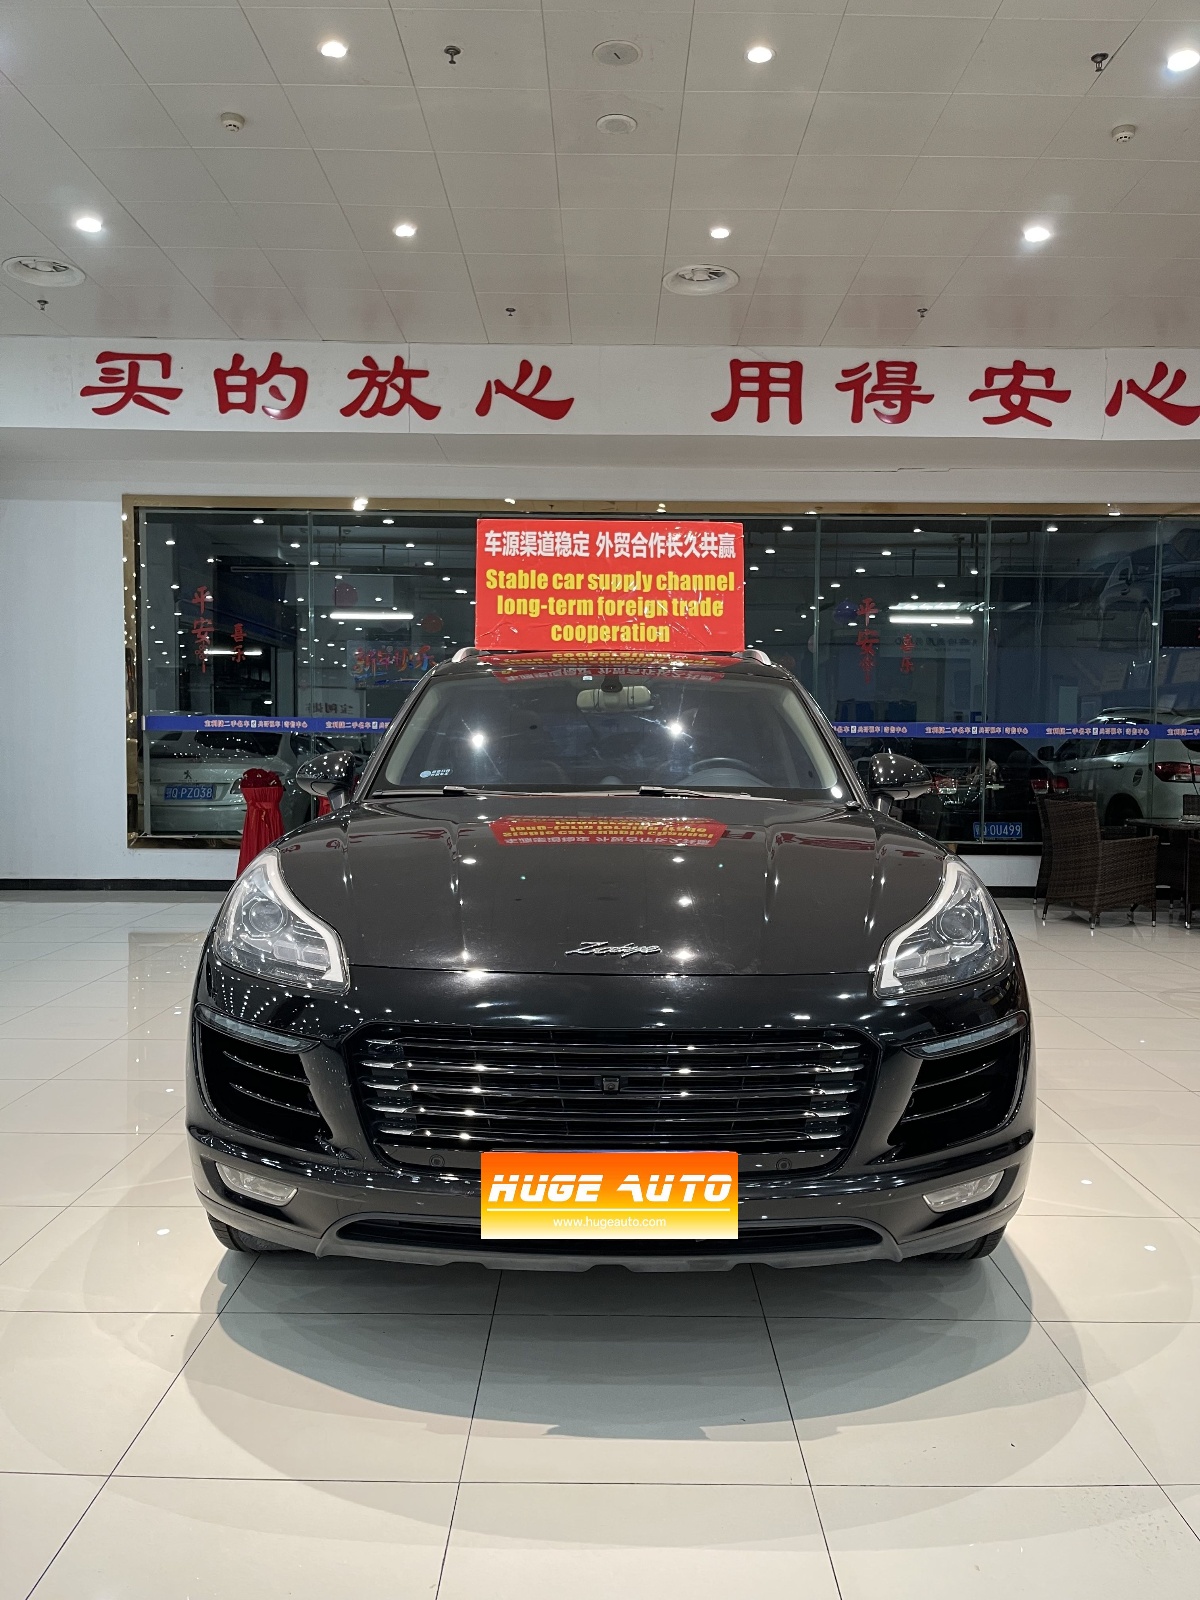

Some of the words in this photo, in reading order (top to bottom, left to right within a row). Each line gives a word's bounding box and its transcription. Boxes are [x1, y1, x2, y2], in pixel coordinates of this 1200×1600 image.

[79, 351, 576, 421] 买的放心
[710, 358, 1200, 428] 用得安心
[484, 530, 590, 558] 车源渠道稳定
[596, 531, 737, 559] 外贸合作长久共赢
[485, 568, 548, 590] Stable
[552, 572, 584, 591] car
[587, 570, 652, 593] supply
[655, 571, 735, 591] channel
[496, 594, 594, 618] long-term
[597, 596, 669, 618] foreign
[671, 597, 724, 617] trade
[550, 622, 670, 643] cooperation
